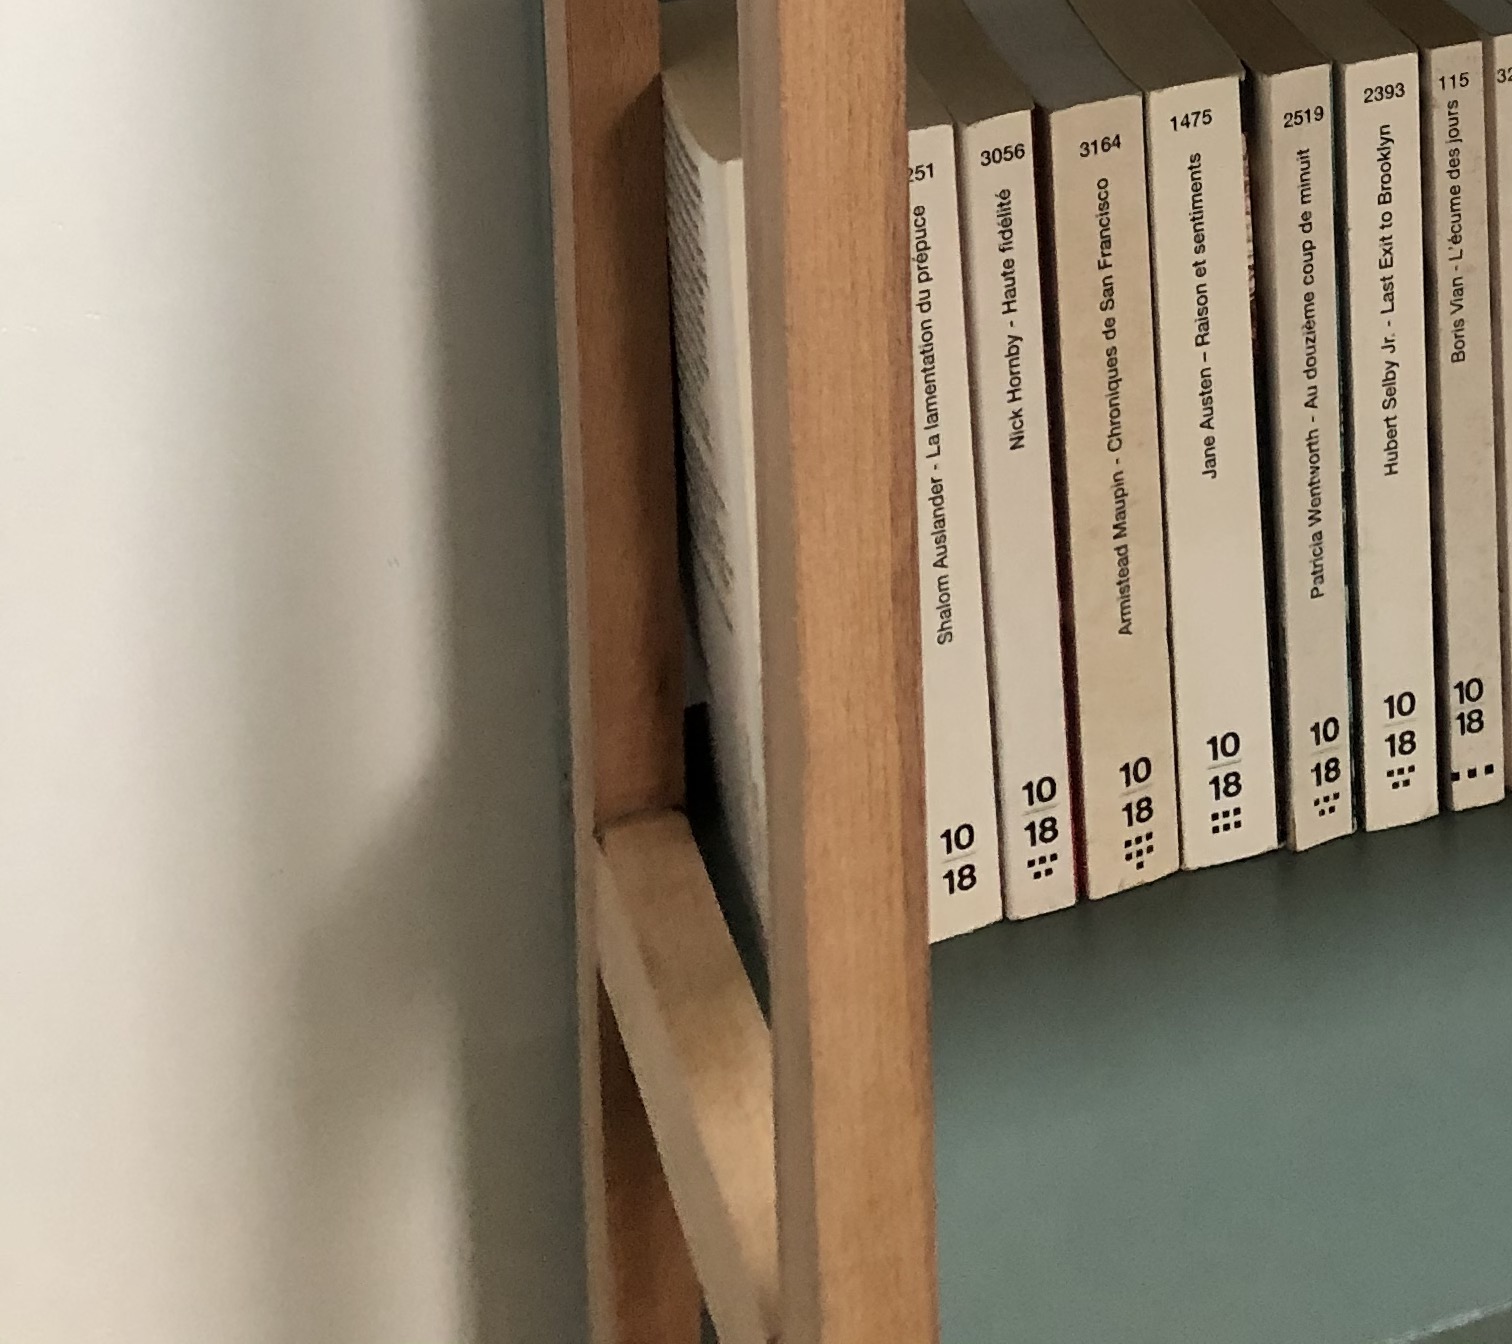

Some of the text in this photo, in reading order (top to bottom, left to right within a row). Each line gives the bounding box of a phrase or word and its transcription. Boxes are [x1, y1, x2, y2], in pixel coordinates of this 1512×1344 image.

[1363, 82, 1406, 104] 2393
[1438, 71, 1470, 91] 115
[1169, 108, 1213, 132] 1475
[1283, 105, 1325, 129] 2519
[1444, 99, 1463, 144] jours
[980, 142, 1026, 167] 3056
[1079, 133, 1122, 158] 3164
[1445, 147, 1461, 181] des
[1295, 147, 1312, 206] minuit
[1375, 124, 1395, 207] Brooklyn
[993, 188, 1014, 254] fidélité
[1186, 152, 1206, 255] sentiments
[1297, 210, 1313, 235] de
[1378, 210, 1393, 231] to
[1094, 177, 1113, 271] Francisco
[1446, 184, 1464, 262] L'écume
[913, 205, 934, 285] prépuce
[1301, 239, 1317, 287] coup
[1377, 234, 1394, 271] Exit
[999, 258, 1018, 316] Haute
[1191, 259, 1207, 279] et
[915, 288, 932, 315] du
[1098, 274, 1115, 313] San
[1379, 274, 1395, 315] Last
[1449, 276, 1464, 316] Vian
[1100, 316, 1117, 341] de
[1193, 282, 1211, 348] Raison
[1300, 291, 1318, 381] douzième
[1380, 333, 1396, 355] Jr.
[1450, 317, 1466, 365] Boris
[919, 318, 940, 431] lamentation
[1003, 334, 1024, 405] Hornby
[1380, 360, 1400, 411] Selby
[1104, 345, 1123, 453] Chroniques
[1197, 366, 1215, 431] Austen
[1302, 384, 1319, 410] Au
[925, 433, 941, 460] La
[1007, 407, 1025, 451] Nick
[1382, 414, 1399, 477] Hubert
[1201, 435, 1217, 480] Jane
[1304, 428, 1322, 529] Wentworth
[927, 476, 949, 569] Auslander
[1110, 470, 1129, 541] Maupin
[1308, 529, 1325, 600] Patricia
[1113, 543, 1133, 636] Armistead
[935, 574, 953, 646] Shalom
[1383, 691, 1416, 720] 10
[1453, 677, 1484, 705] 10
[1309, 716, 1340, 747] 10
[1455, 708, 1485, 736] 18
[1206, 731, 1241, 761] 10
[1384, 729, 1417, 758] 18
[1119, 756, 1152, 788] 10
[1208, 771, 1243, 801] 18
[1310, 756, 1341, 787] 18
[1021, 776, 1057, 807] 10
[1023, 815, 1059, 847] 18
[1121, 796, 1154, 828] 18
[939, 823, 975, 855] 10
[942, 863, 977, 895] 18
